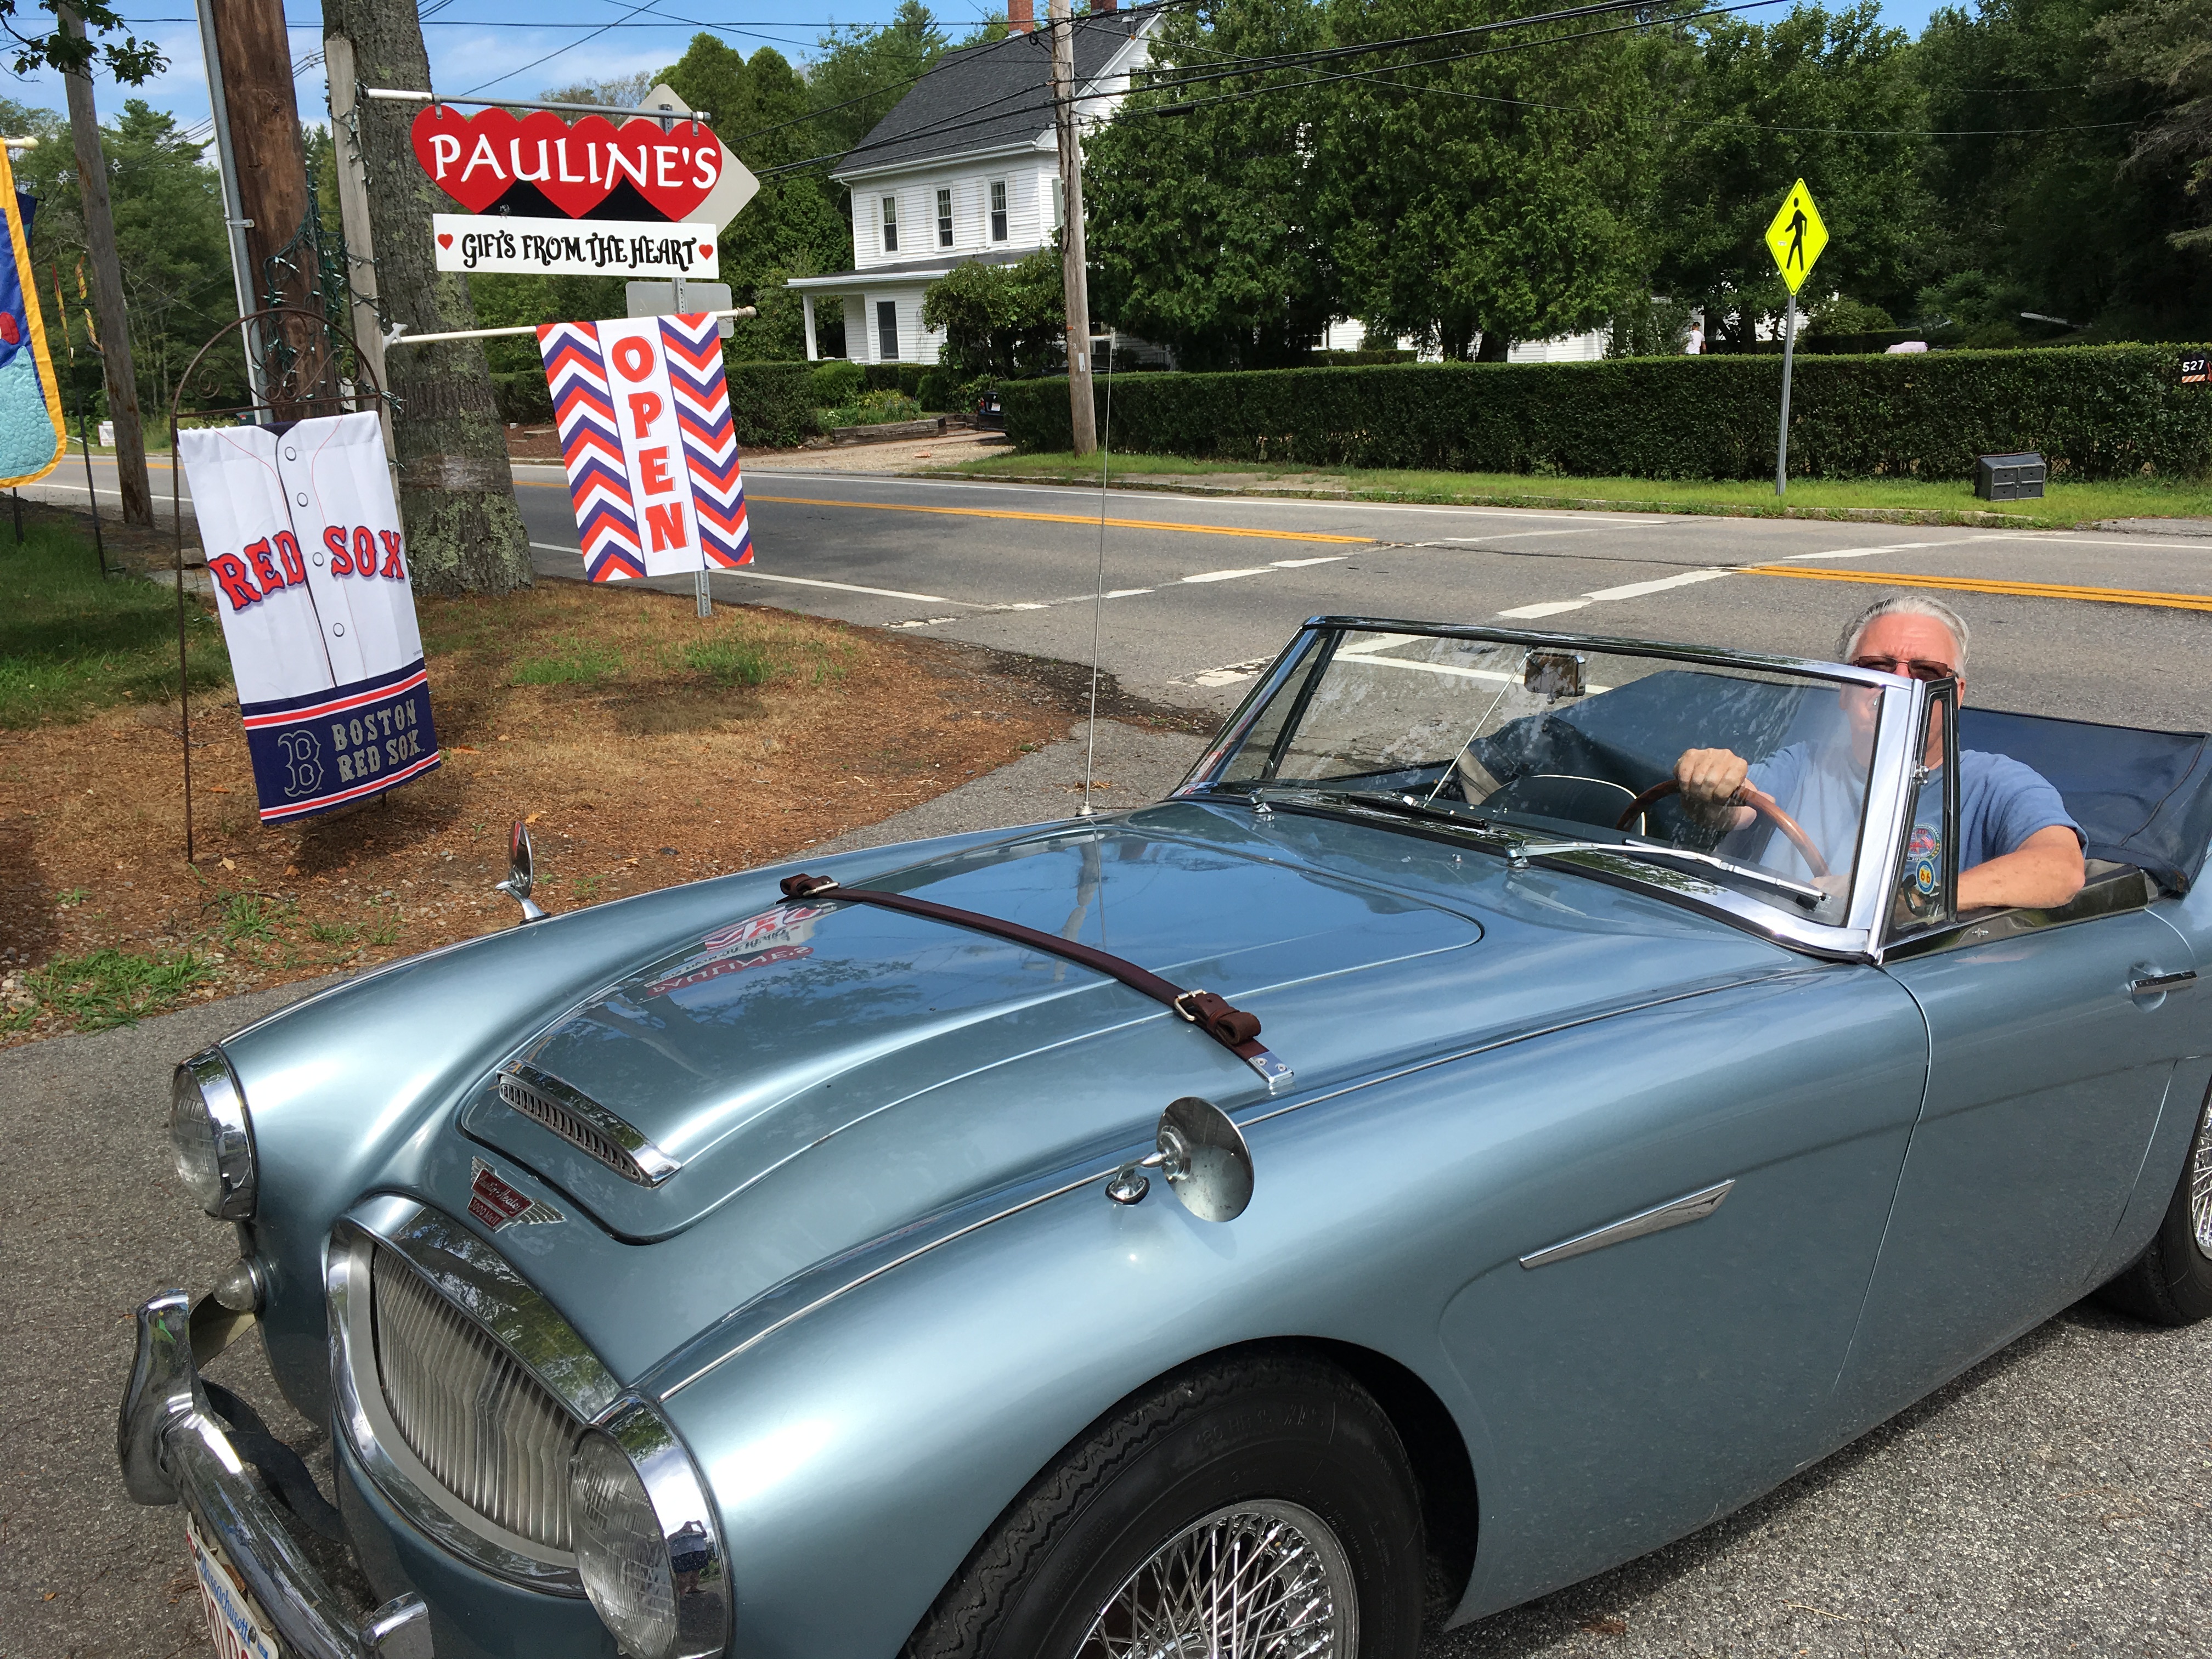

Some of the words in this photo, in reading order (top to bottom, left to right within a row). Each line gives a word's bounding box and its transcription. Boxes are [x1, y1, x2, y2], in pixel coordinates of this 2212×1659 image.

[428, 133, 716, 190] PAULINE'S
[462, 229, 516, 268] GIFTS
[520, 234, 586, 267] FROM
[585, 232, 628, 267] THE
[628, 235, 697, 272] HEART
[2182, 359, 2204, 373] 527
[611, 335, 690, 553] OPEN
[208, 529, 306, 611] RED
[323, 524, 405, 580] SOX
[331, 698, 417, 752] BOSTON
[336, 745, 381, 783] RED
[386, 729, 421, 766] SOX
[1921, 869, 1931, 884] 66
